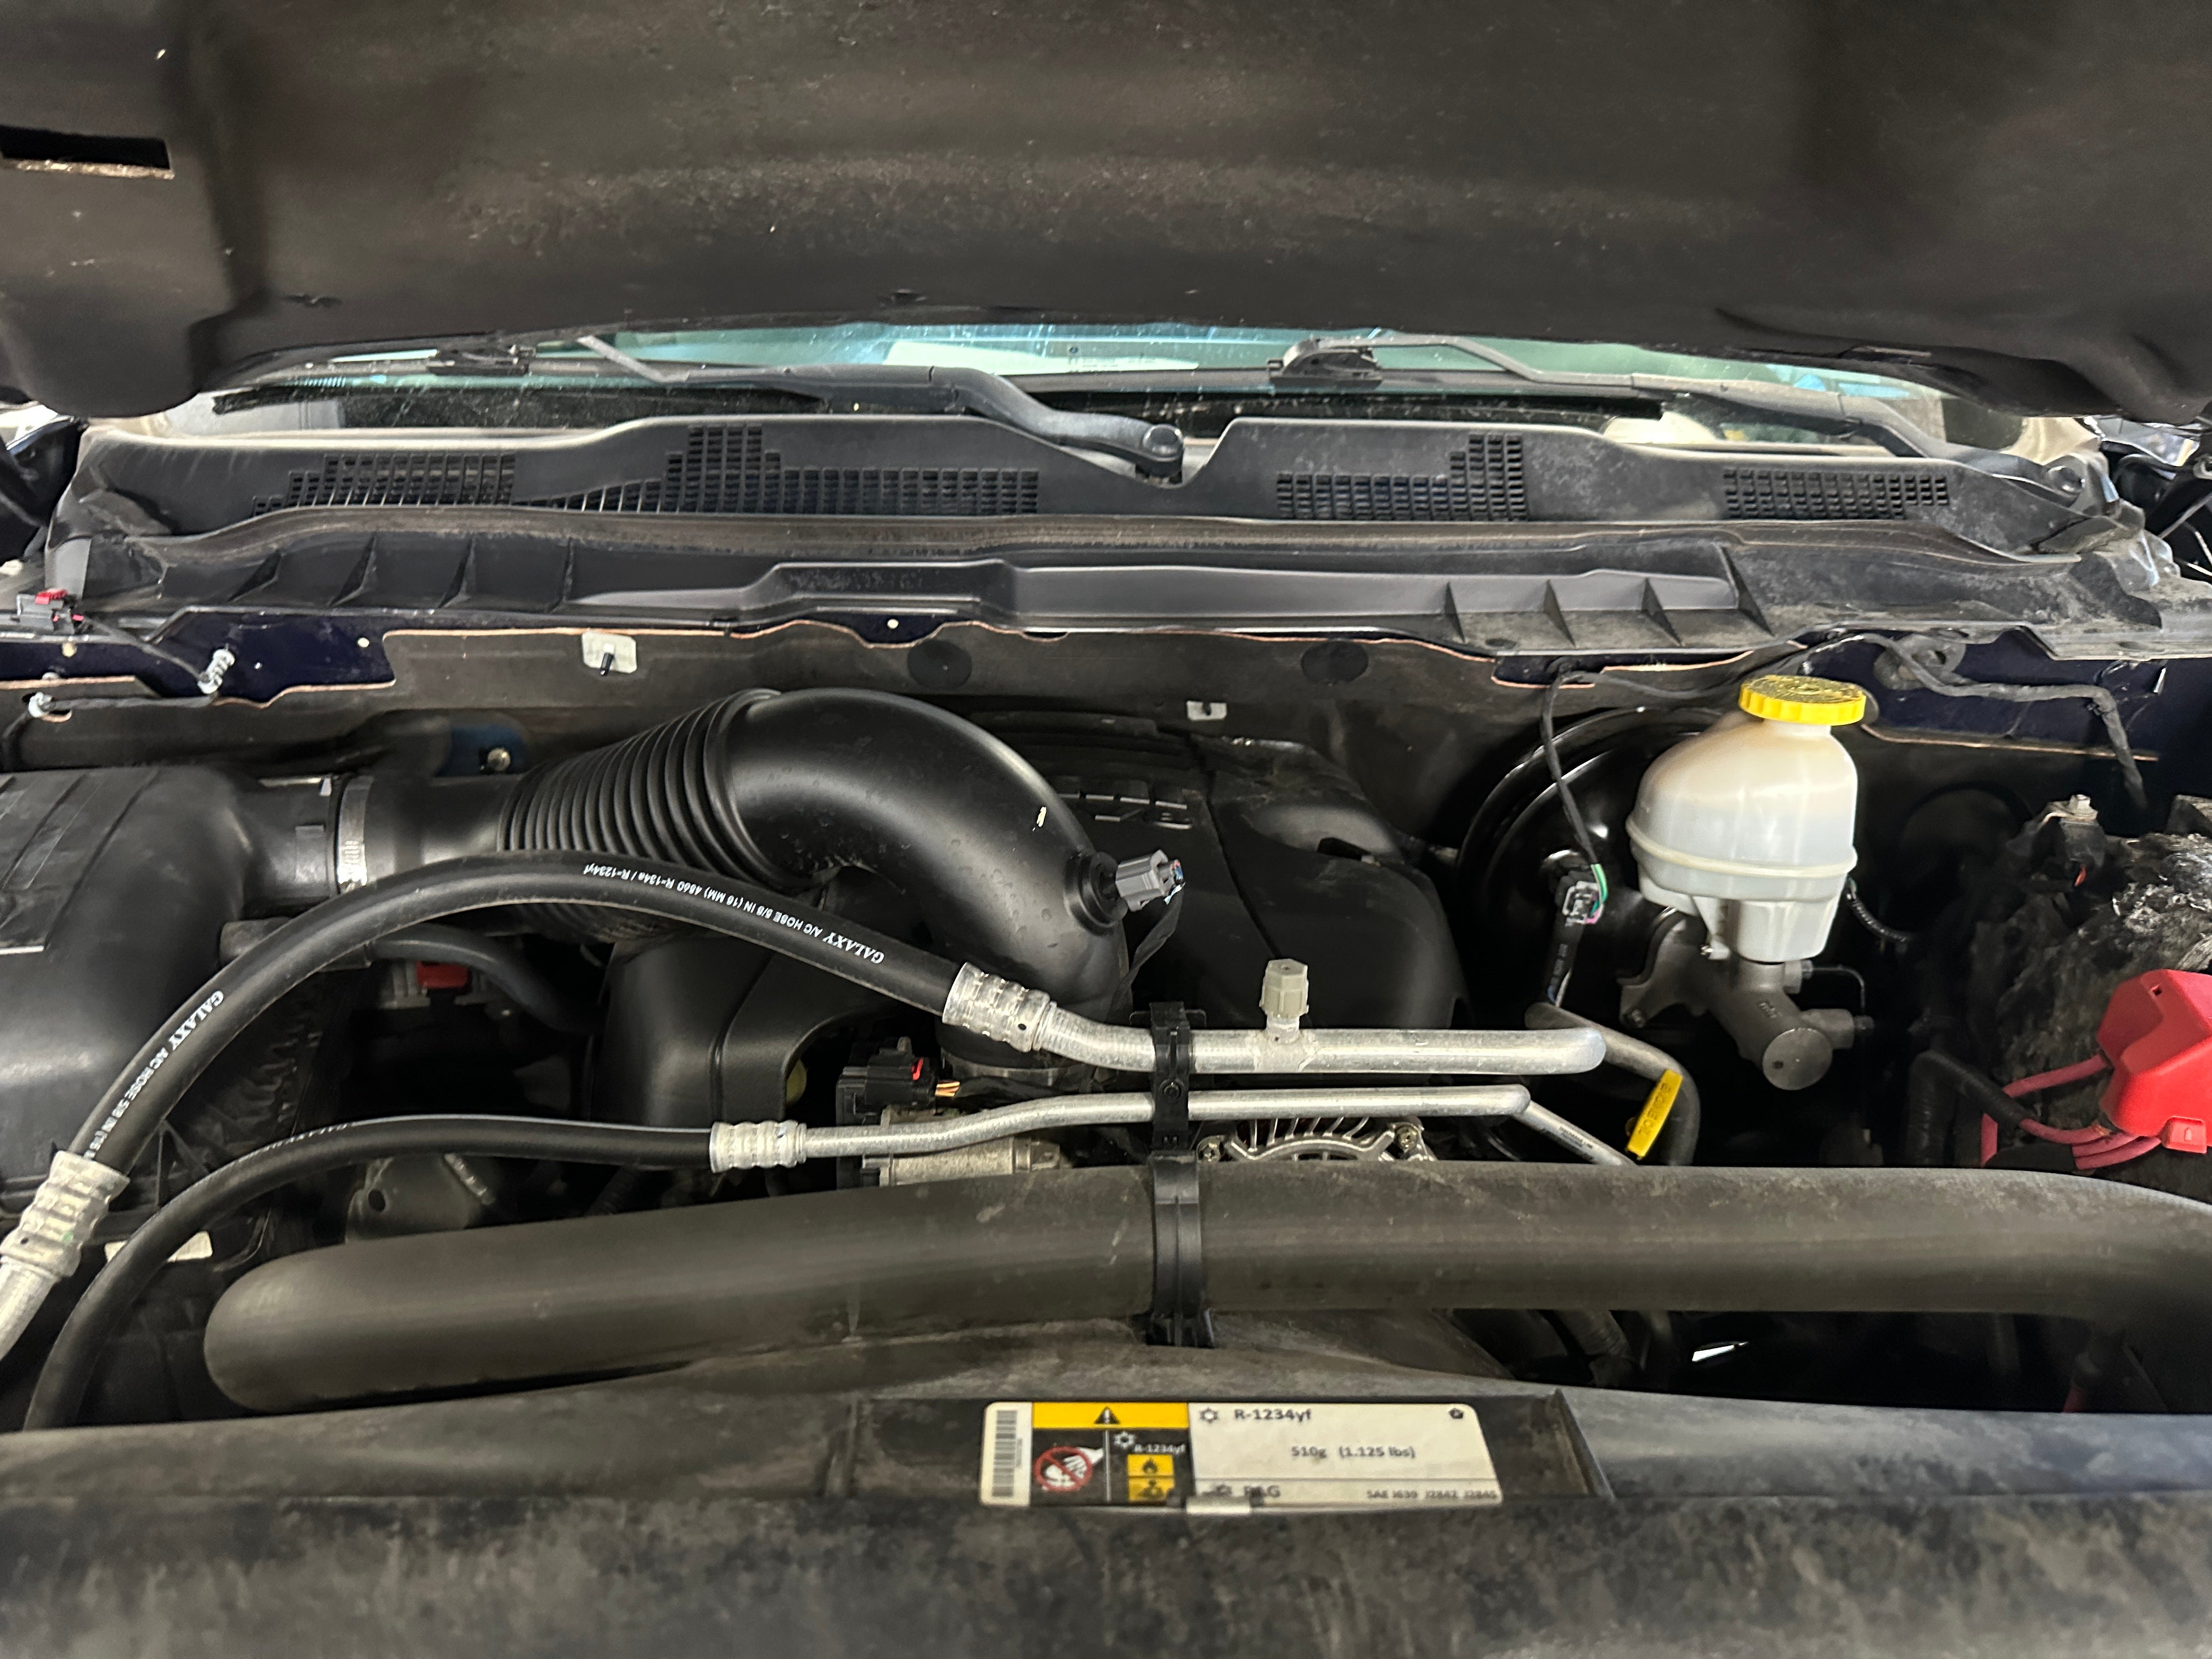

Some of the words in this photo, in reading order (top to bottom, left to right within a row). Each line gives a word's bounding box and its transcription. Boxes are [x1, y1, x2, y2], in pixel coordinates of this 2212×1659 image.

[583, 862, 631, 881] R-1234yf
[637, 871, 675, 889] R-134a
[704, 886, 726, 903] MM)
[743, 900, 757, 913] IN
[772, 911, 804, 931] HOSE
[803, 923, 823, 938] A/C
[822, 932, 885, 964] GALAXY
[168, 990, 224, 1051] GALAXY
[124, 1066, 155, 1101] HOSE
[1234, 1408, 1312, 1423] R-1234yf
[1291, 1446, 1327, 1459] 510g
[1339, 1446, 1385, 1459] (1.125
[1388, 1446, 1416, 1459] lbs)
[1367, 1490, 1388, 1499] SAE
